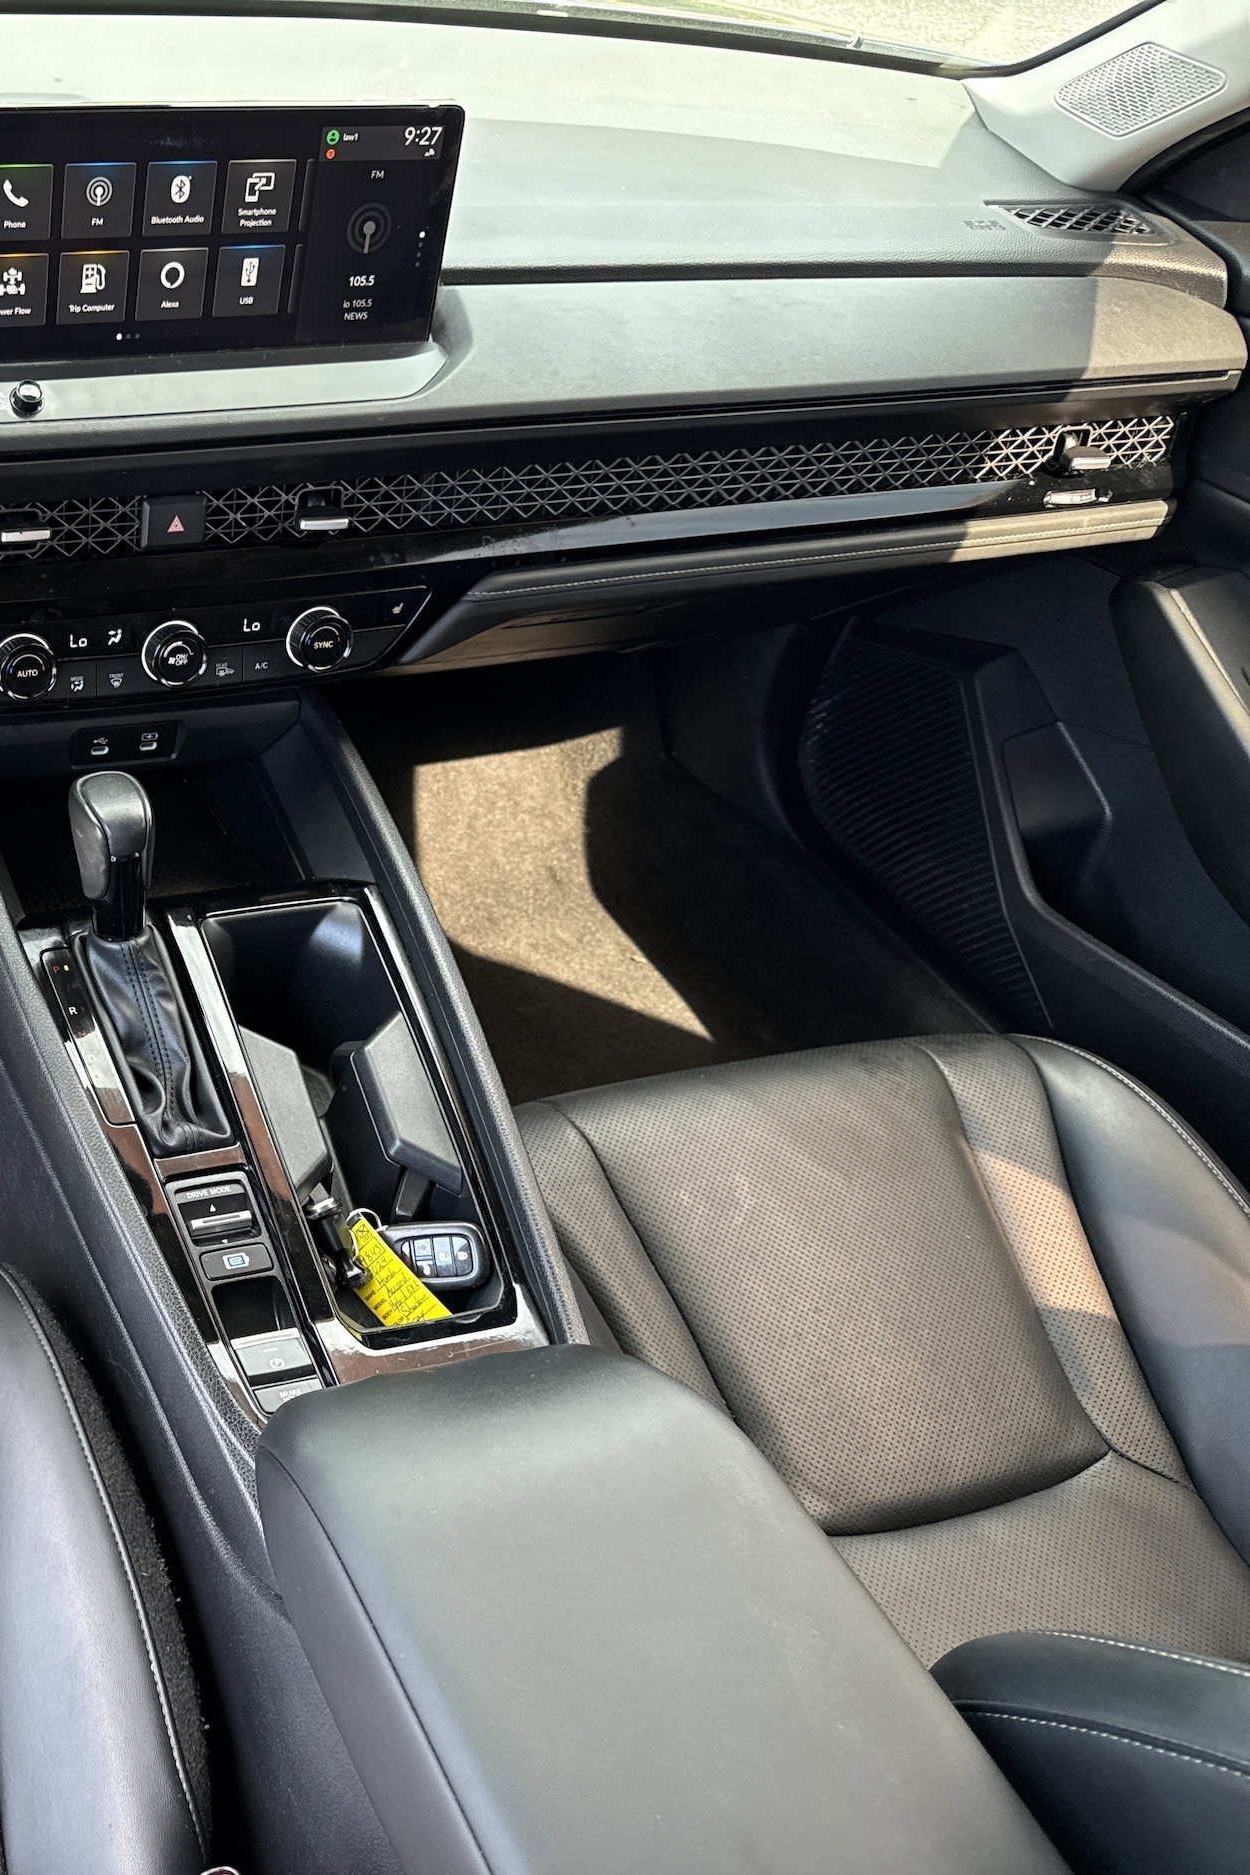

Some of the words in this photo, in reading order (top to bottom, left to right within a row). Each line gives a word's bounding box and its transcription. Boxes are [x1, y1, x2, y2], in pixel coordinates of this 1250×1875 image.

[404, 126, 443, 146] 9:27
[371, 170, 385, 179] FM
[237, 207, 277, 218] Smartphone
[91, 217, 104, 227] FM
[151, 215, 183, 225] Bluetooth
[184, 214, 204, 224] Audio
[239, 218, 272, 228] Projection
[3, 220, 26, 230] Phone
[348, 275, 375, 287] 105.5
[160, 300, 179, 309] Alexa
[239, 296, 254, 305] USB
[351, 298, 373, 308] 105.5
[14, 306, 31, 316] Flow
[68, 304, 82, 314] Trip
[82, 303, 115, 313] Computer
[344, 311, 368, 321] NEWS
[313, 640, 334, 650] SYNC
[254, 662, 269, 670] A/C
[16, 668, 39, 678] AUTO
[52, 965, 61, 974] P
[68, 1006, 78, 1016] R
[78, 1030, 88, 1038] N
[88, 1054, 96, 1062] D
[186, 1190, 209, 1199] DRIVE
[210, 1185, 232, 1195] MODE
